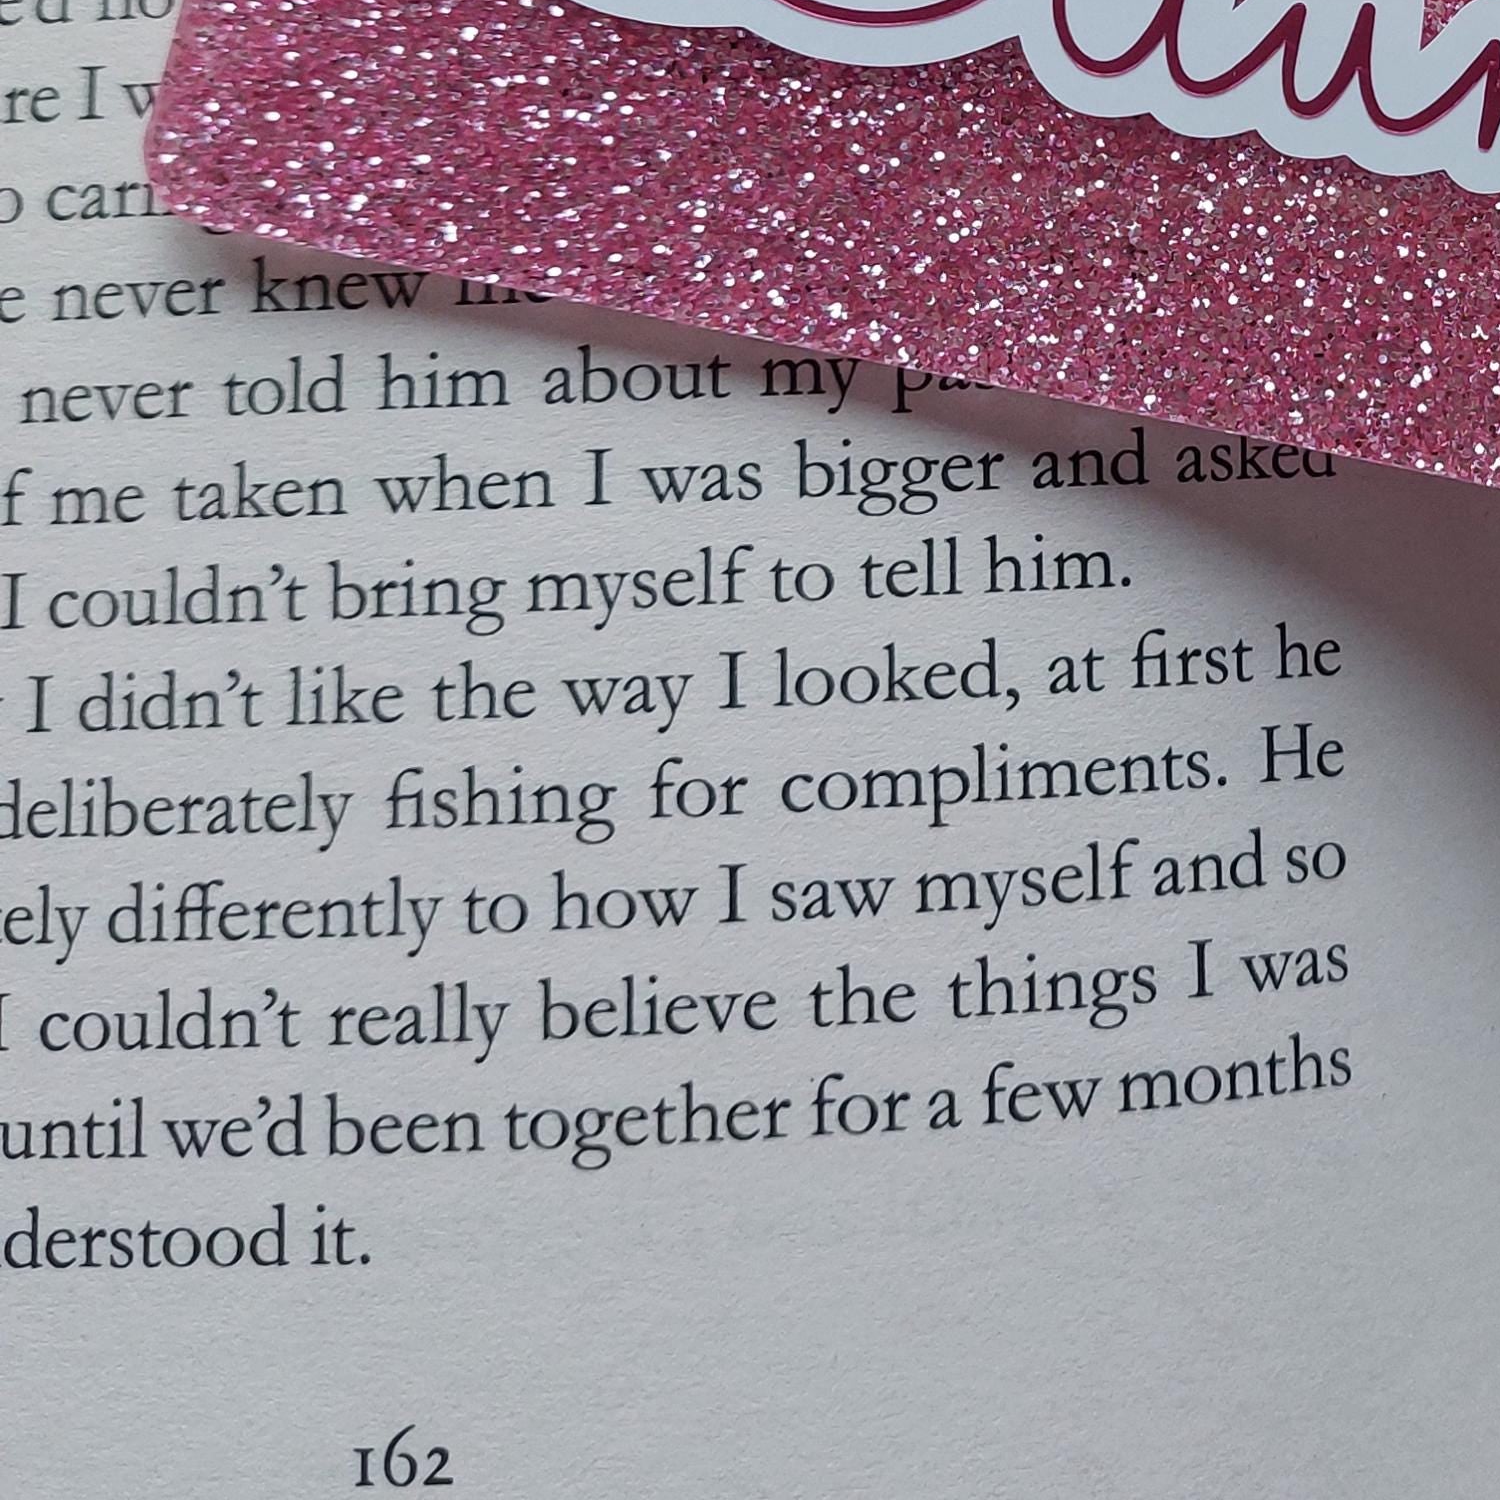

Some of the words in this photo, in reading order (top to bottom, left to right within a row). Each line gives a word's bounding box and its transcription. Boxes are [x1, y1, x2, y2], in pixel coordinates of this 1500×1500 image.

[50, 277, 227, 322] never
[247, 254, 429, 314] knew
[16, 379, 195, 425] never
[220, 352, 349, 417] told
[375, 351, 512, 411] him
[542, 343, 733, 405] about
[46, 562, 309, 630] couldn’t
[324, 558, 508, 637] bring
[525, 543, 755, 632] myself
[768, 557, 836, 604] to
[858, 531, 964, 600] tell
[983, 533, 1132, 594] him.
[25, 674, 55, 734] I
[77, 668, 265, 733] didn’t
[285, 663, 405, 726] like
[429, 659, 537, 723] the
[559, 673, 695, 735] way
[717, 650, 748, 710] I
[772, 636, 1021, 713] looked,
[1047, 646, 1106, 695] at
[1130, 627, 1255, 689] first
[1274, 621, 1342, 680] he
[384, 764, 619, 846] fishing
[647, 756, 749, 819] for
[780, 741, 1228, 830] compliments.
[1259, 722, 1345, 784] He
[107, 874, 445, 959] differently
[461, 886, 529, 936] to
[549, 868, 700, 932] how
[717, 862, 749, 925] I
[771, 876, 897, 923] saw
[914, 837, 1141, 932] myself
[1152, 826, 1268, 898] and
[1285, 841, 1347, 885] so
[0, 1095, 149, 1161] until
[160, 1091, 308, 1160] we’d
[323, 1091, 486, 1157] been
[503, 1079, 793, 1173] together
[809, 1071, 912, 1138] for
[927, 1088, 963, 1131] a
[981, 1060, 1104, 1127] few
[1117, 1031, 1352, 1115] months
[309, 1203, 371, 1266] it.
[352, 1423, 454, 1488] 162
